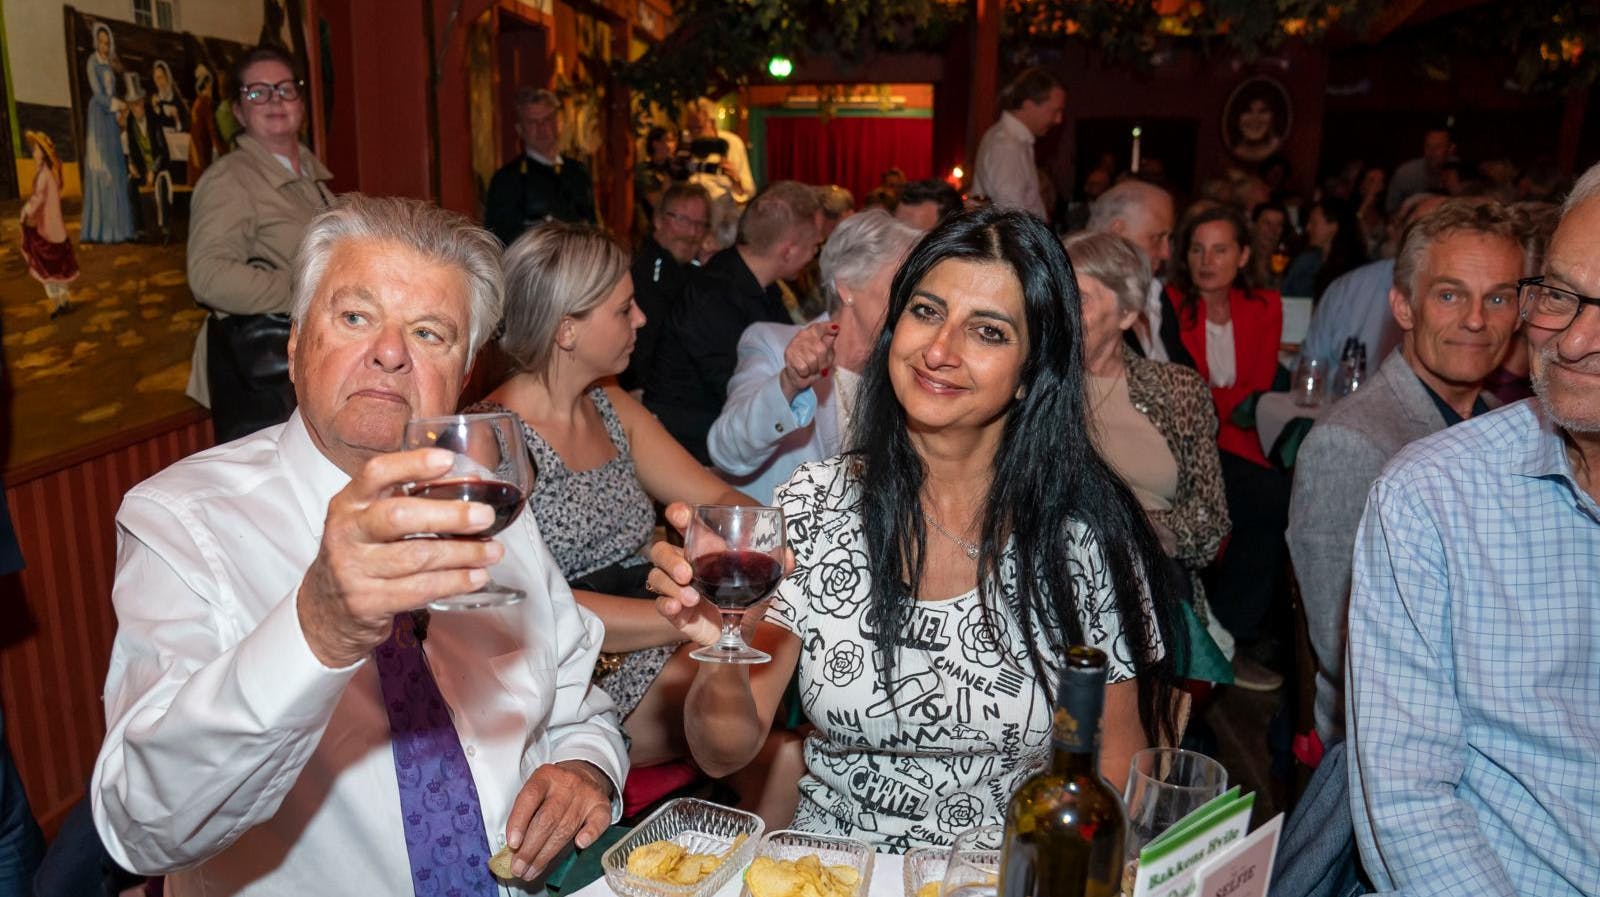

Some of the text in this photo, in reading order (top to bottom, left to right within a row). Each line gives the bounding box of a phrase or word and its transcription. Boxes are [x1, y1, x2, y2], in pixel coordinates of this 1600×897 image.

[859, 603, 950, 651] CNEL
[934, 656, 995, 698] CHANEL
[848, 767, 929, 821] CHANEL
[911, 825, 954, 846] CHAN
